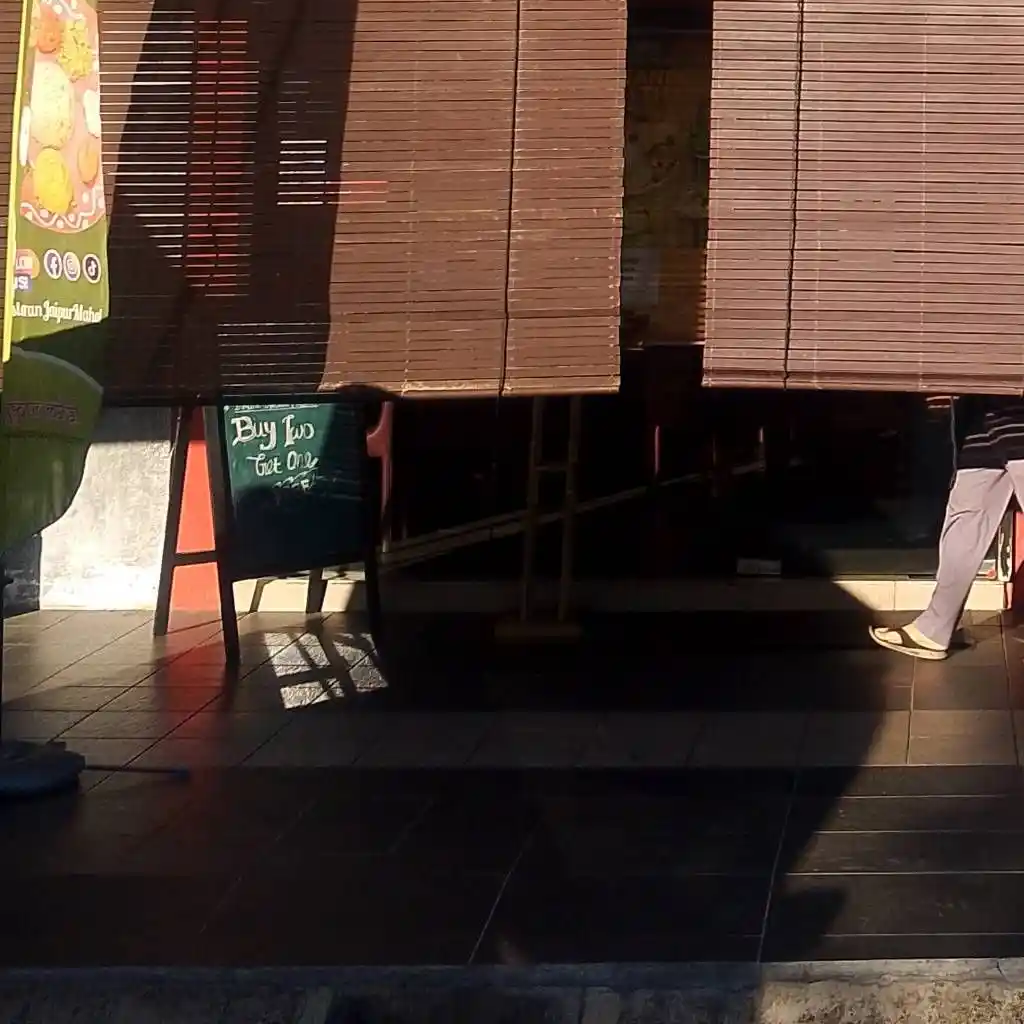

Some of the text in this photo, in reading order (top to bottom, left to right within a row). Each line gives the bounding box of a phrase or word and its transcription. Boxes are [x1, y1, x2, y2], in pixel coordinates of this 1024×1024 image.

[230, 414, 315, 451] Buy Two
[246, 450, 319, 476] Get One
